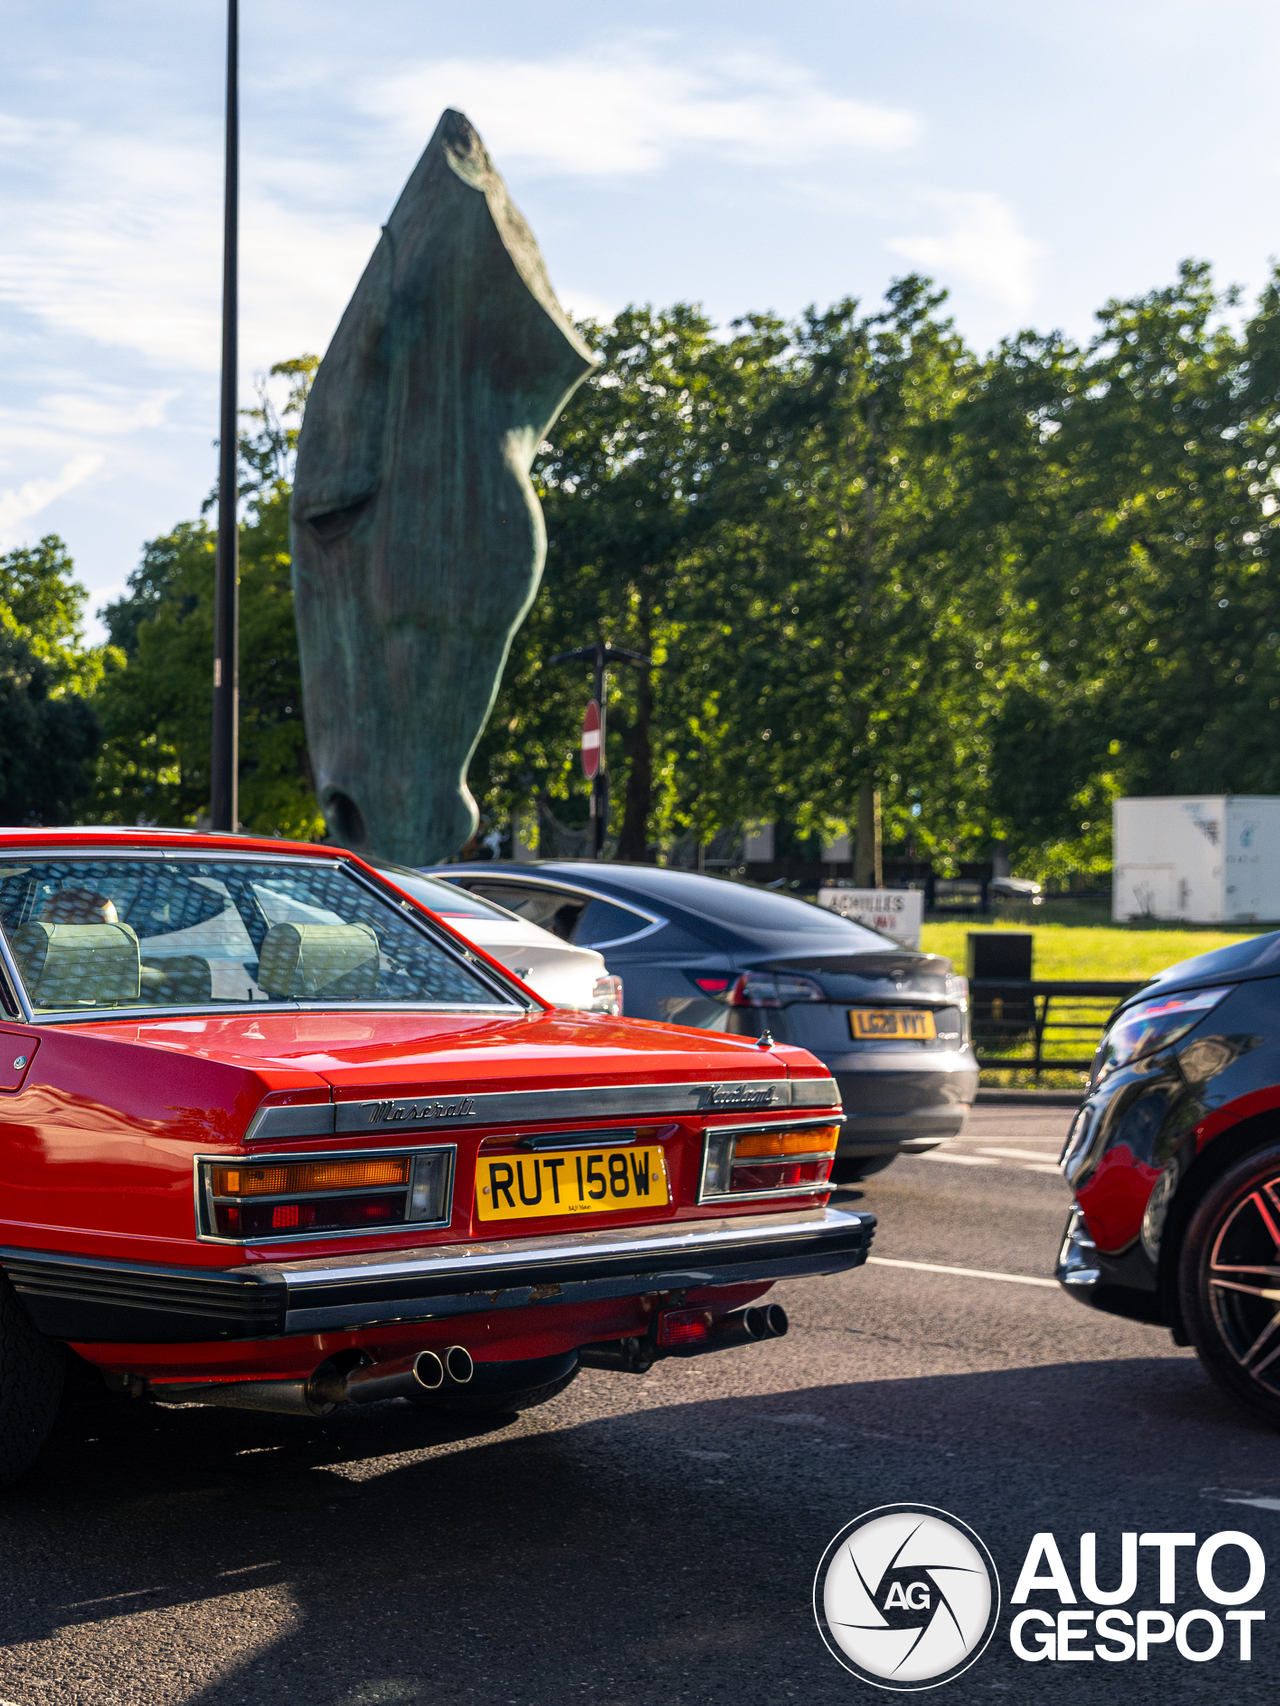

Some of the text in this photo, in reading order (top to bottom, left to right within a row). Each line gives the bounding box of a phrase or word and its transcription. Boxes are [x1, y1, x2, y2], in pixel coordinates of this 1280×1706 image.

[829, 894, 906, 914] ACHILLES
[359, 1096, 477, 1123] Maserati
[488, 1151, 651, 1210] RUT 158W
